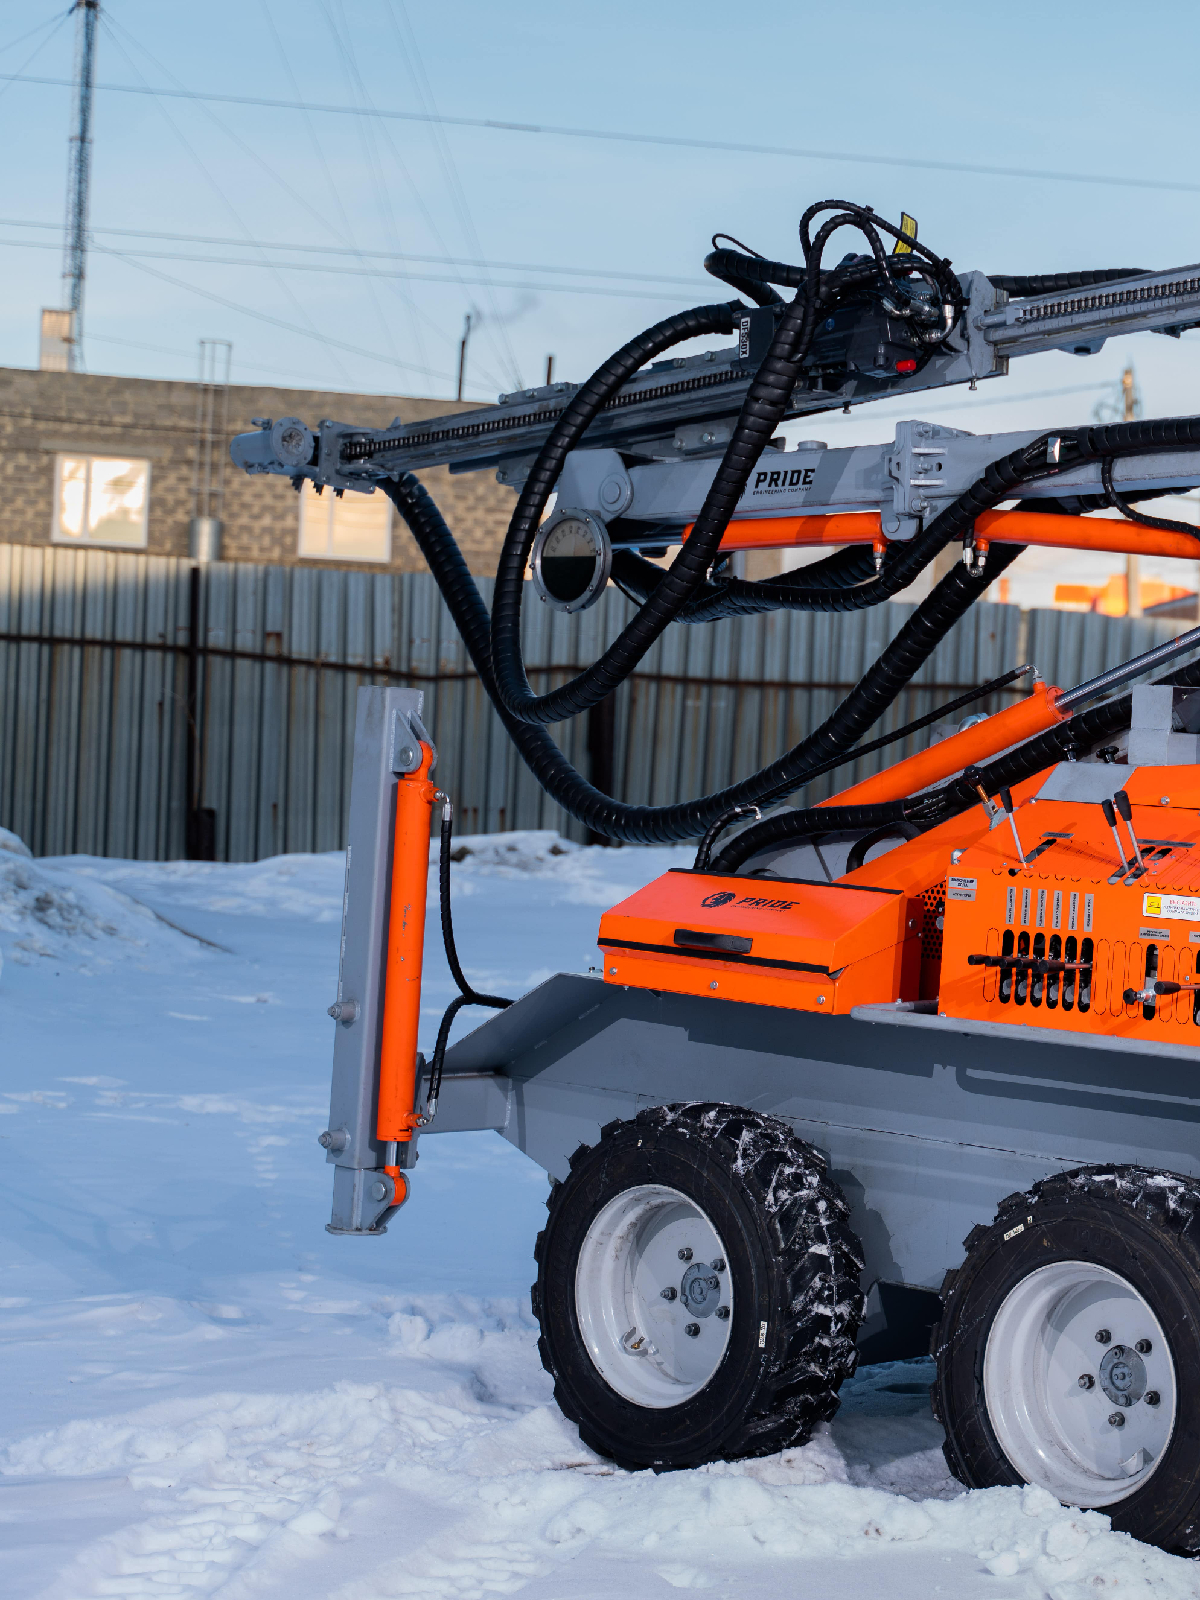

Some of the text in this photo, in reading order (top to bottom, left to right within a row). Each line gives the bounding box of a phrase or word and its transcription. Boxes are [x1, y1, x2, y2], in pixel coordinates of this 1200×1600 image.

[741, 320, 749, 356] DF530X
[754, 468, 816, 489] PRIDE
[752, 488, 787, 496] ENGINEERING
[736, 896, 800, 910] PRIDE
